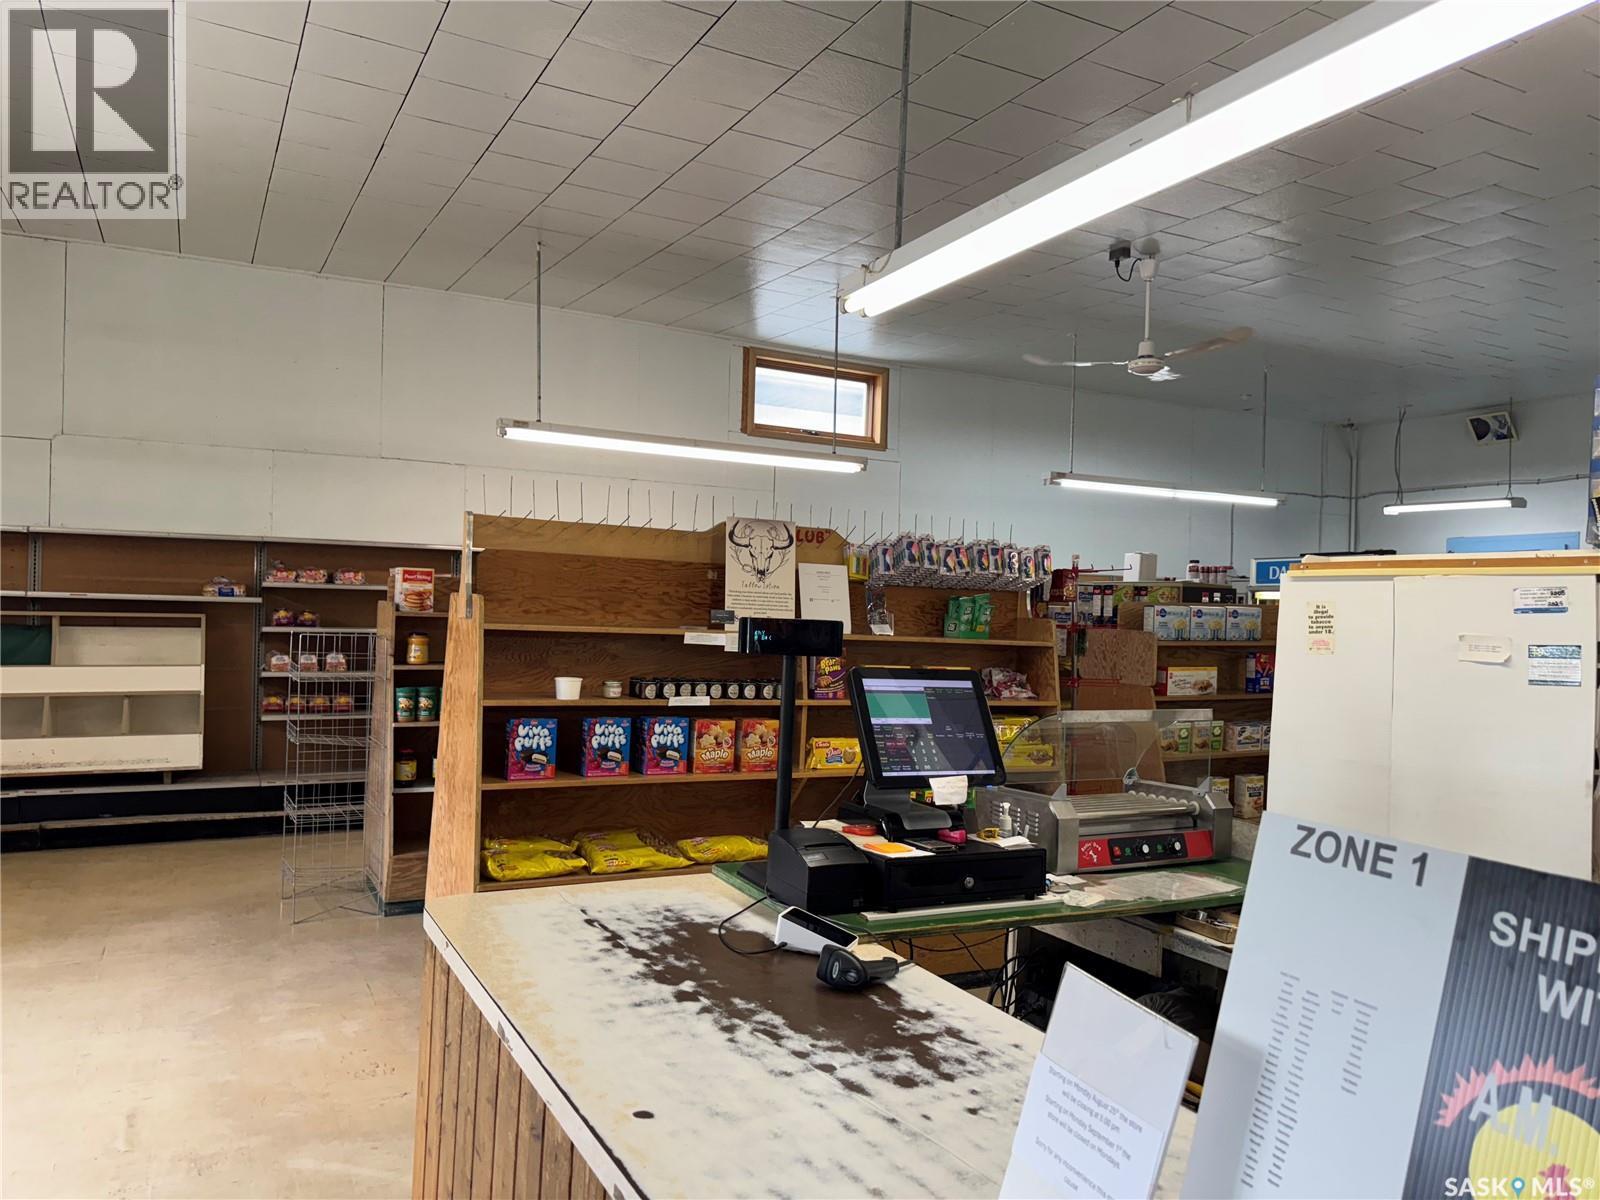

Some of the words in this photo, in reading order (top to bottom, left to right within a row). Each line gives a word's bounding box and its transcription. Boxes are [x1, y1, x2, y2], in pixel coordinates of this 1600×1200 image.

[701, 749, 729, 761] Maple
[747, 748, 773, 760] Maple
[1290, 824, 1398, 880] ZONE
[1411, 852, 1429, 887] 1
[1489, 911, 1600, 974] SHIP
[1538, 973, 1600, 1027] WI
[1048, 1065, 1066, 1085] Starting
[1073, 1081, 1092, 1101] Monday
[1045, 1093, 1063, 1114] Starting
[1069, 1111, 1088, 1131] Monday
[1087, 1123, 1115, 1149] September
